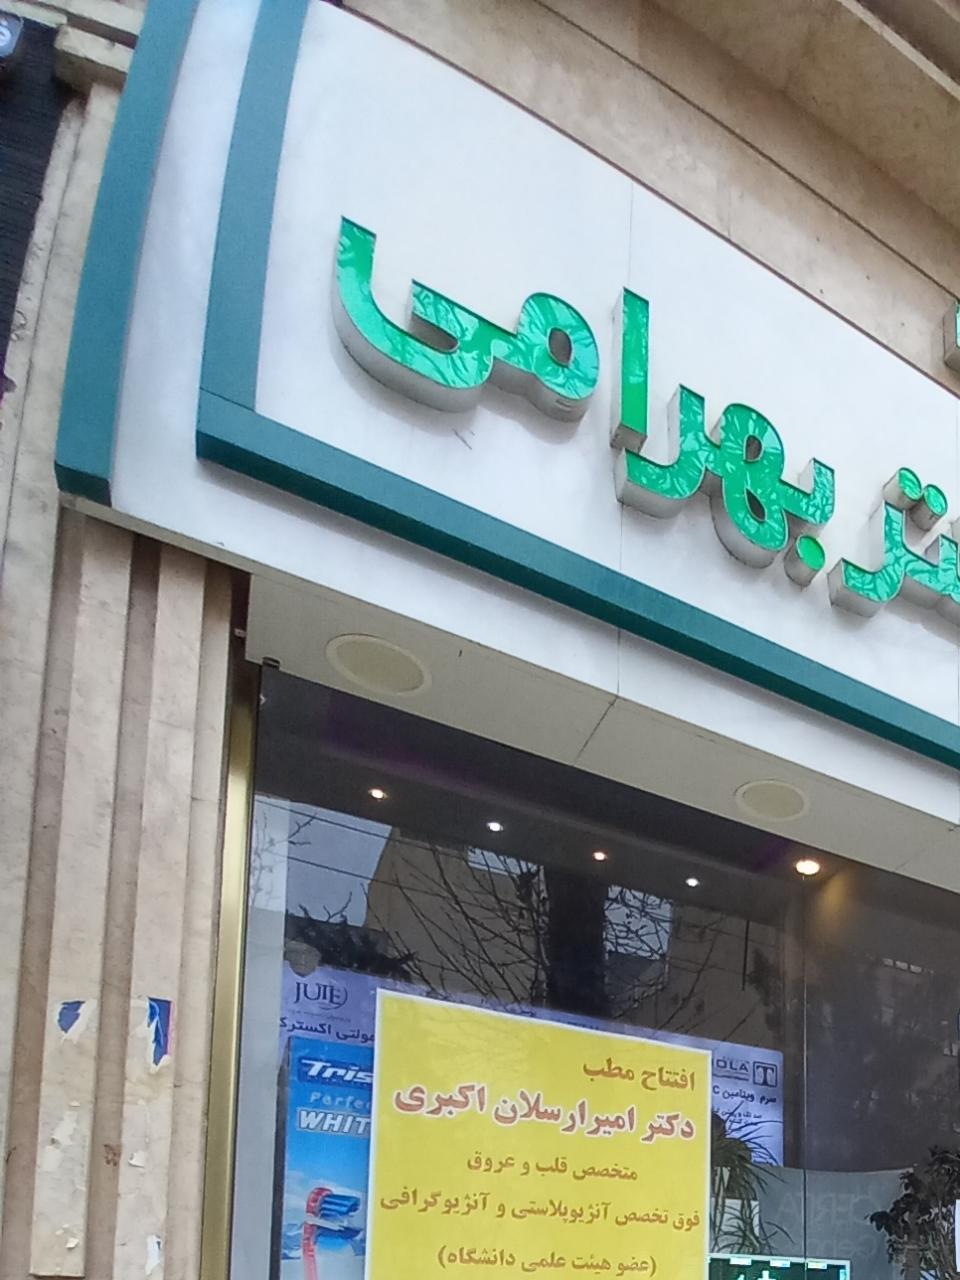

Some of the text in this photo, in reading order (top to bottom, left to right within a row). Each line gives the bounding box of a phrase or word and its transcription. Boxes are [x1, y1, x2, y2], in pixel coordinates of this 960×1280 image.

[334, 215, 836, 584] بهرامی
[279, 1017, 332, 1035] اکسترک
[301, 1059, 373, 1084] Tris
[583, 1057, 696, 1091] افتتاح مطب
[395, 1084, 486, 1115] اکبری
[712, 1084, 720, 1095] C
[299, 1109, 371, 1136] WHIT
[641, 1113, 695, 1142] دکتر
[467, 1151, 638, 1181] متخصص قلب و عروق
[380, 1186, 491, 1216] آنژیوگرافی
[495, 1202, 506, 1218] و
[615, 1207, 669, 1226] تخصص
[672, 1210, 700, 1231] فوق
[437, 1245, 516, 1269] دانشگاه)
[521, 1252, 567, 1272] علمی
[571, 1254, 612, 1275] هیئت
